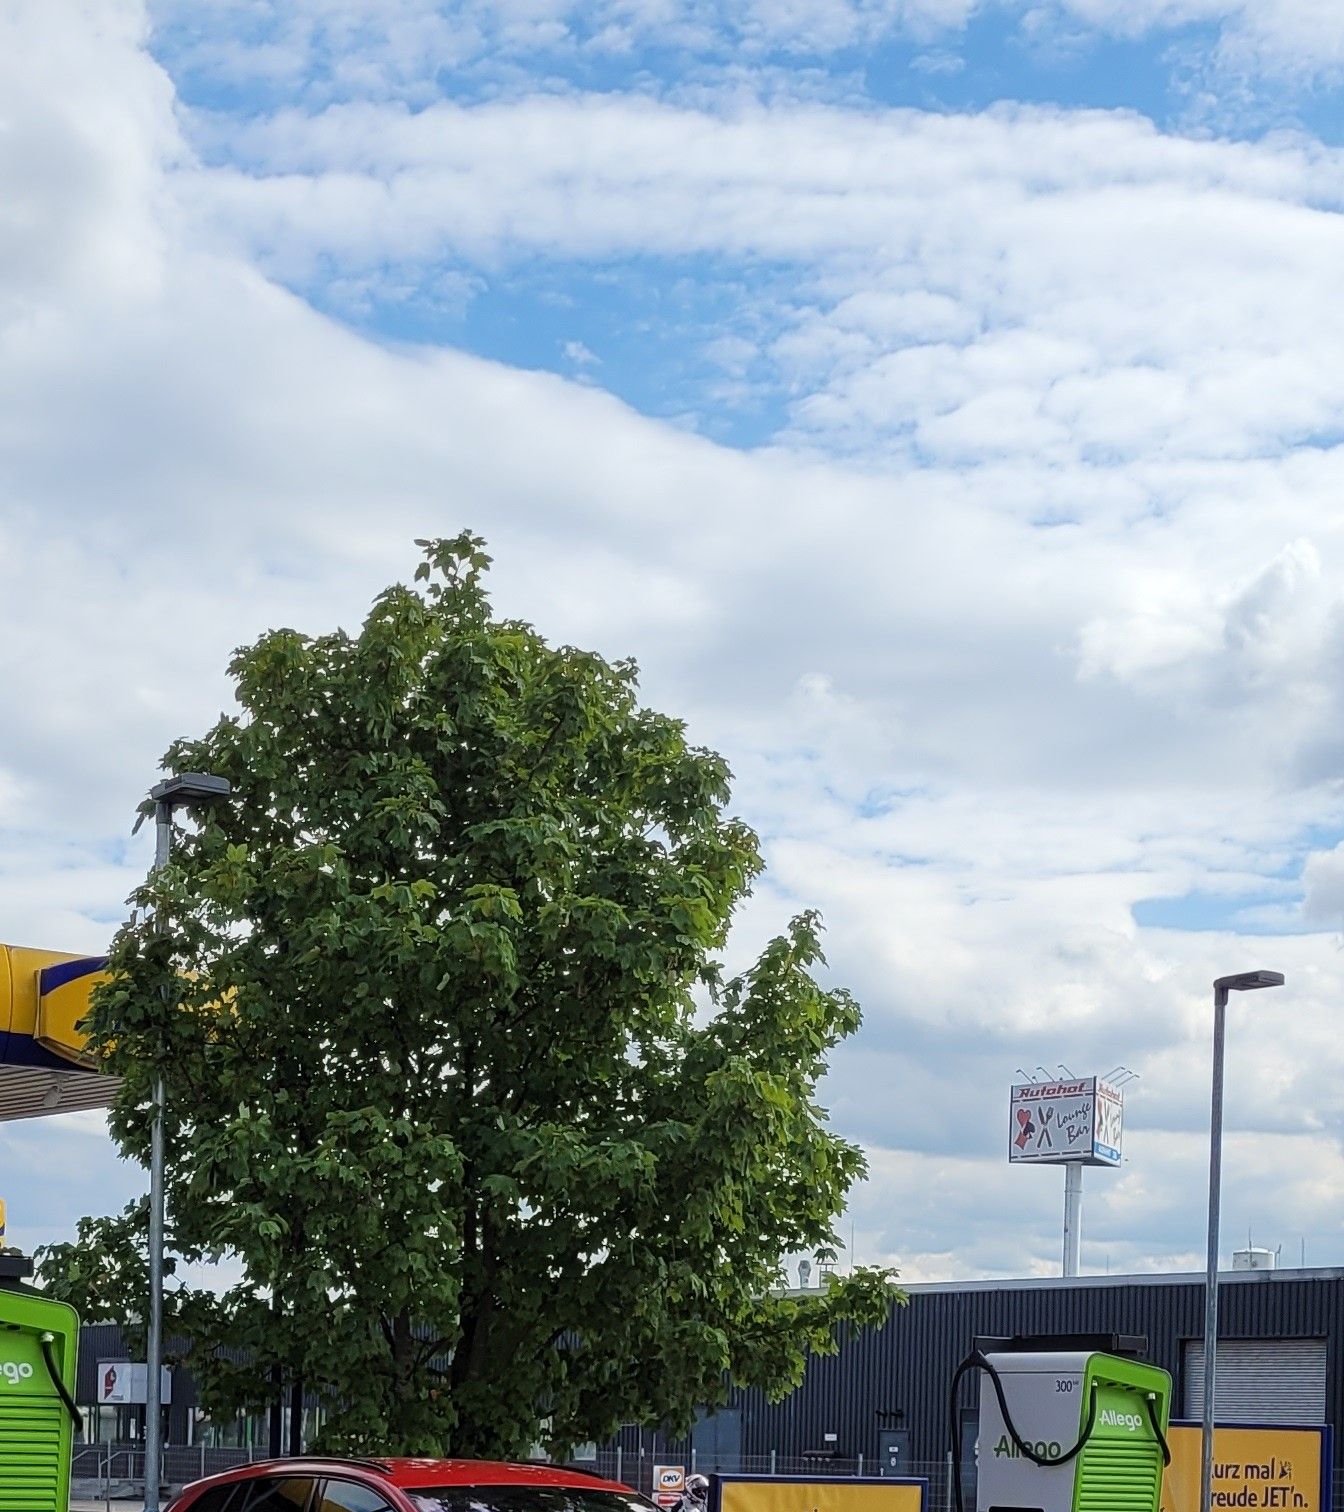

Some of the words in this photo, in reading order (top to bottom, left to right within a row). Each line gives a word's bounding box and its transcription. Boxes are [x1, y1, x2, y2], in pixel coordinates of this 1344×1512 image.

[1057, 1103, 1091, 1129] Lounge
[1066, 1124, 1090, 1145] Bar
[1056, 1380, 1072, 1392] 300
[1099, 1410, 1142, 1431] Allego
[663, 1475, 680, 1483] DKV
[1212, 1464, 1240, 1479] urz
[1245, 1458, 1275, 1480] mal
[1211, 1485, 1257, 1507] reude
[1261, 1486, 1309, 1508] JET'n.
